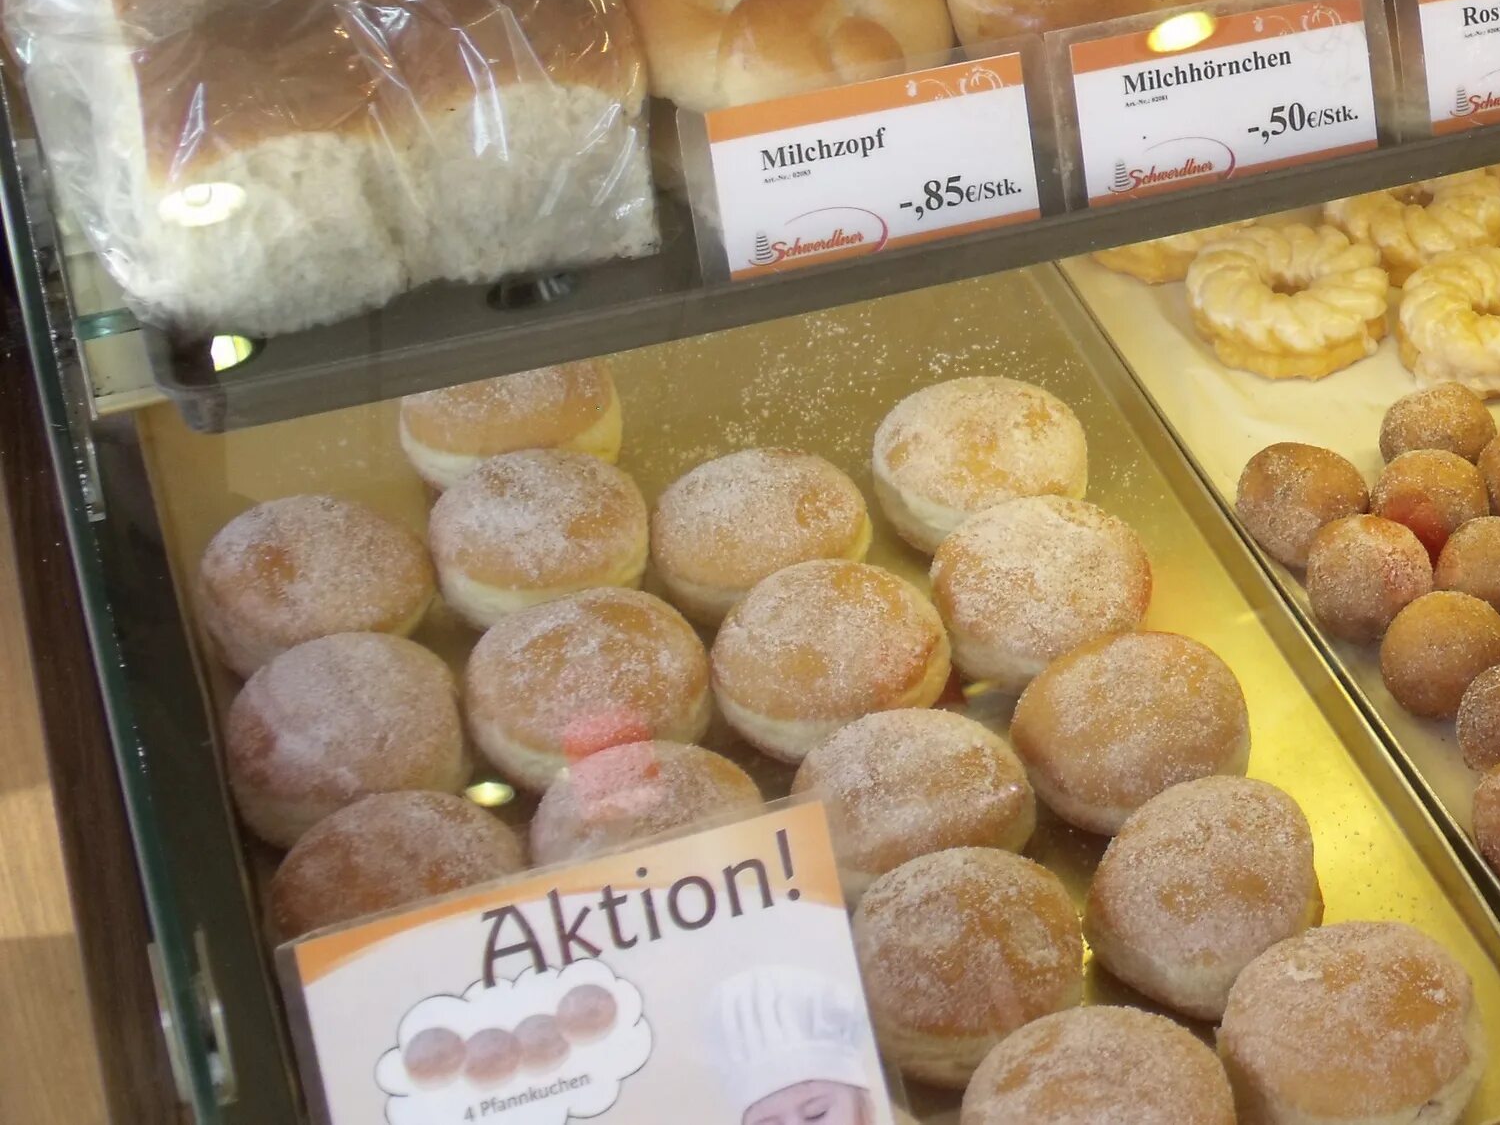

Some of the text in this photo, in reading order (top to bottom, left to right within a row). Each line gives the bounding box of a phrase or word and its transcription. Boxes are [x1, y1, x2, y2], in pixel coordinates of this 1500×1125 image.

[1122, 48, 1293, 96] Milchhörnchen
[1247, 102, 1360, 146] -,50€/Stk.
[760, 127, 887, 172] Milchzopf
[1126, 158, 1216, 190] Schwerdtner
[899, 175, 1023, 221] -,85€/Stk.
[769, 227, 865, 264] Schwerdtner
[480, 827, 803, 989] Aktion!
[463, 1072, 592, 1123] 4 Pfannkuchen
